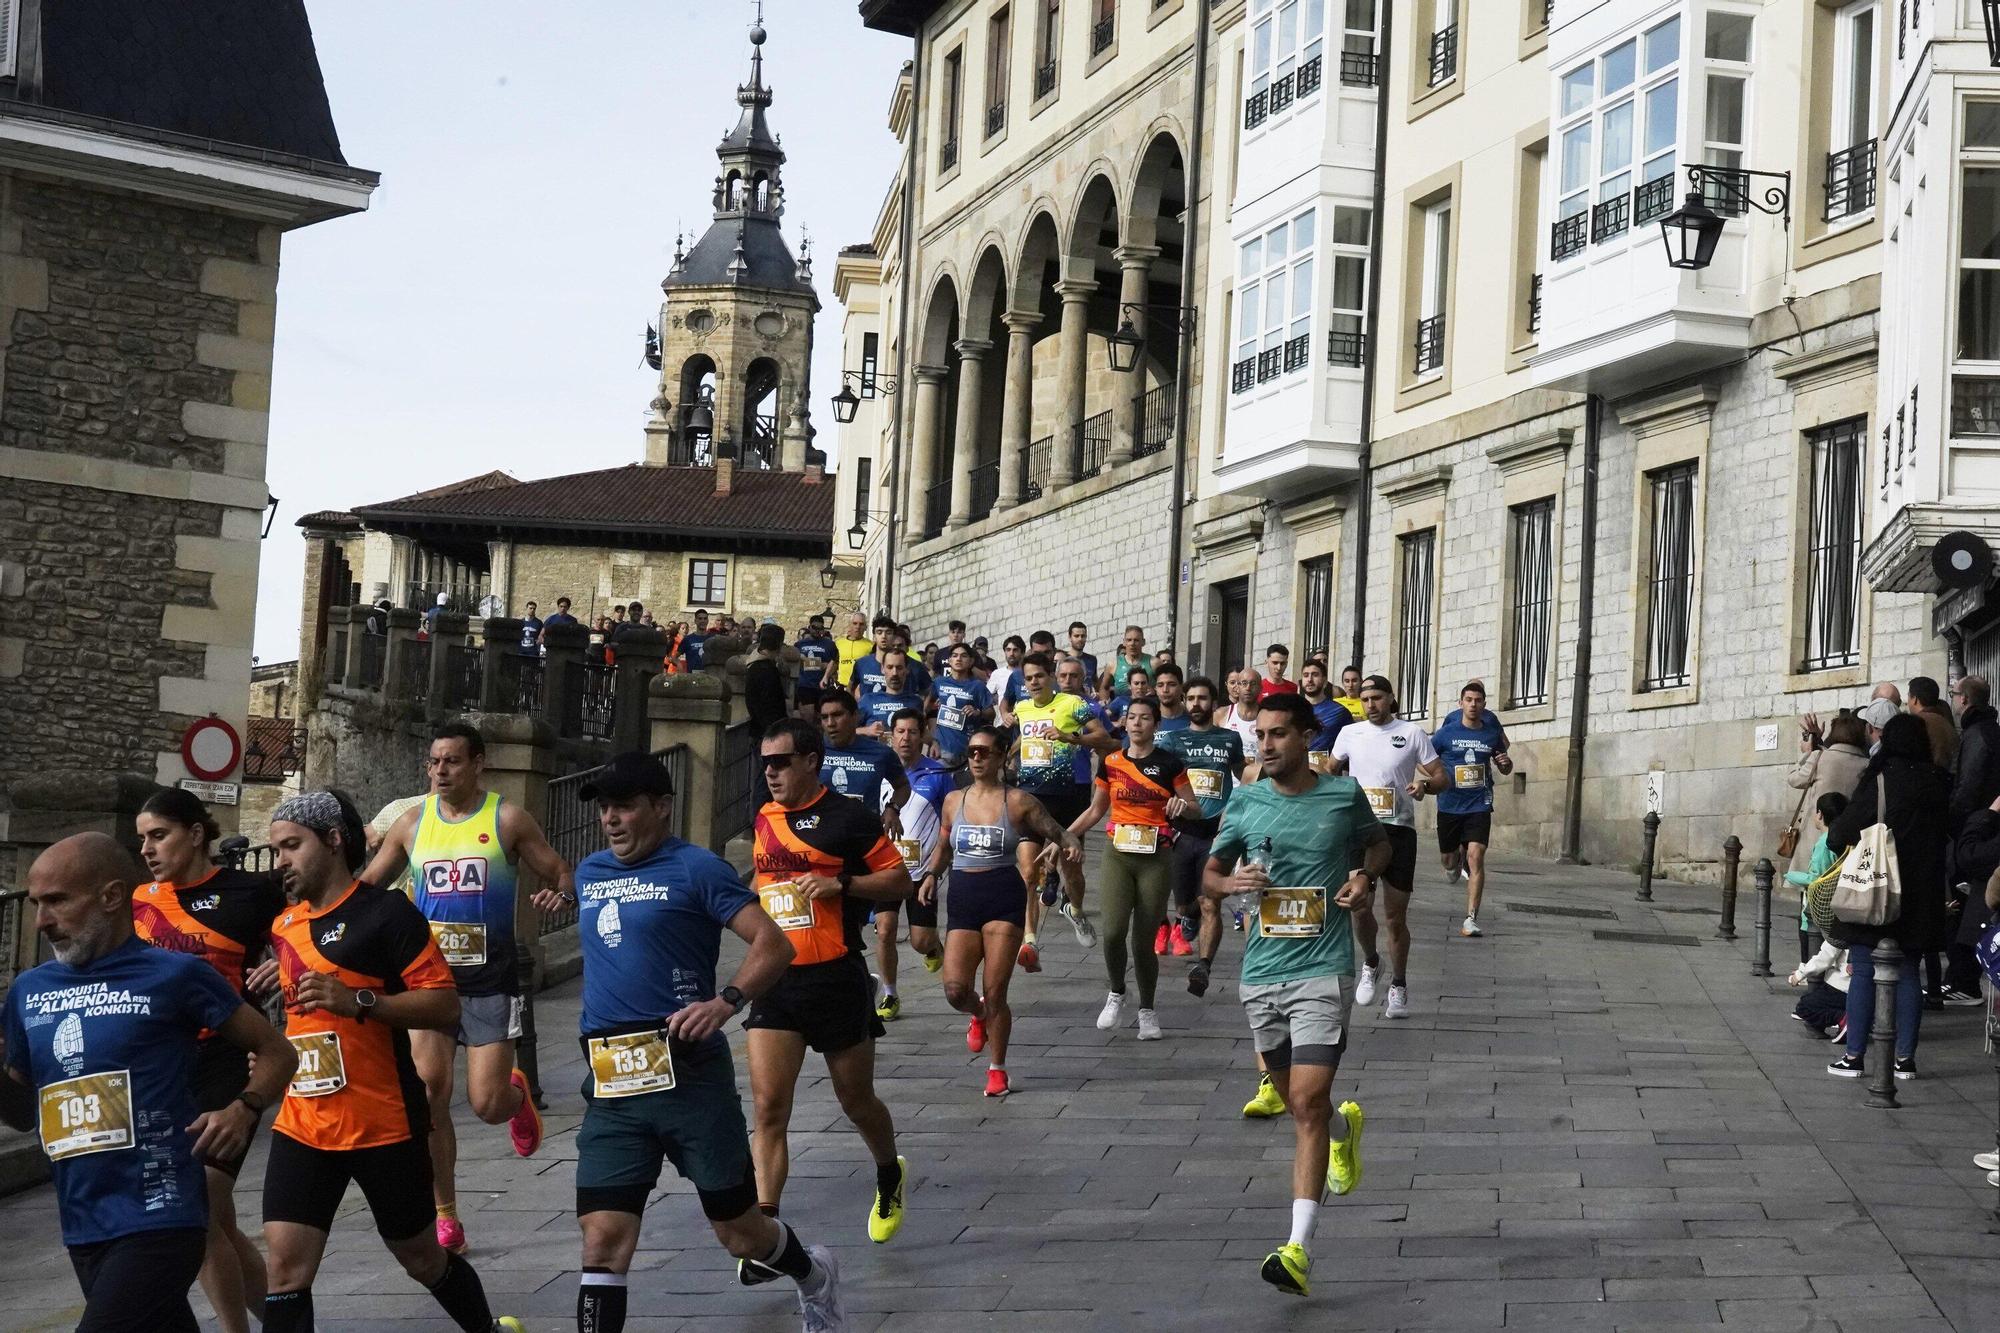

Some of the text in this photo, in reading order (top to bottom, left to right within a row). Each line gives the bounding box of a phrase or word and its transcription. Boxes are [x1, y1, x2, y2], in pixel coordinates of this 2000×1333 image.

[968, 834, 991, 848] 946
[756, 851, 811, 869] FORONDA
[590, 882, 654, 900] ALMENDRA
[592, 877, 639, 891] CONQUISTA
[620, 892, 669, 904] KONKISTA
[769, 894, 794, 914] 100
[1278, 900, 1307, 919] 447
[440, 934, 470, 950] 262
[26, 982, 108, 1004] LA CONQUISTA
[39, 990, 132, 1014] ALMENDRA
[132, 995, 151, 1004] REN
[84, 1004, 151, 1018] KONKISTA
[62, 1057, 84, 1066] VITORIA
[612, 1048, 648, 1074] 133
[58, 1094, 101, 1129] 193
